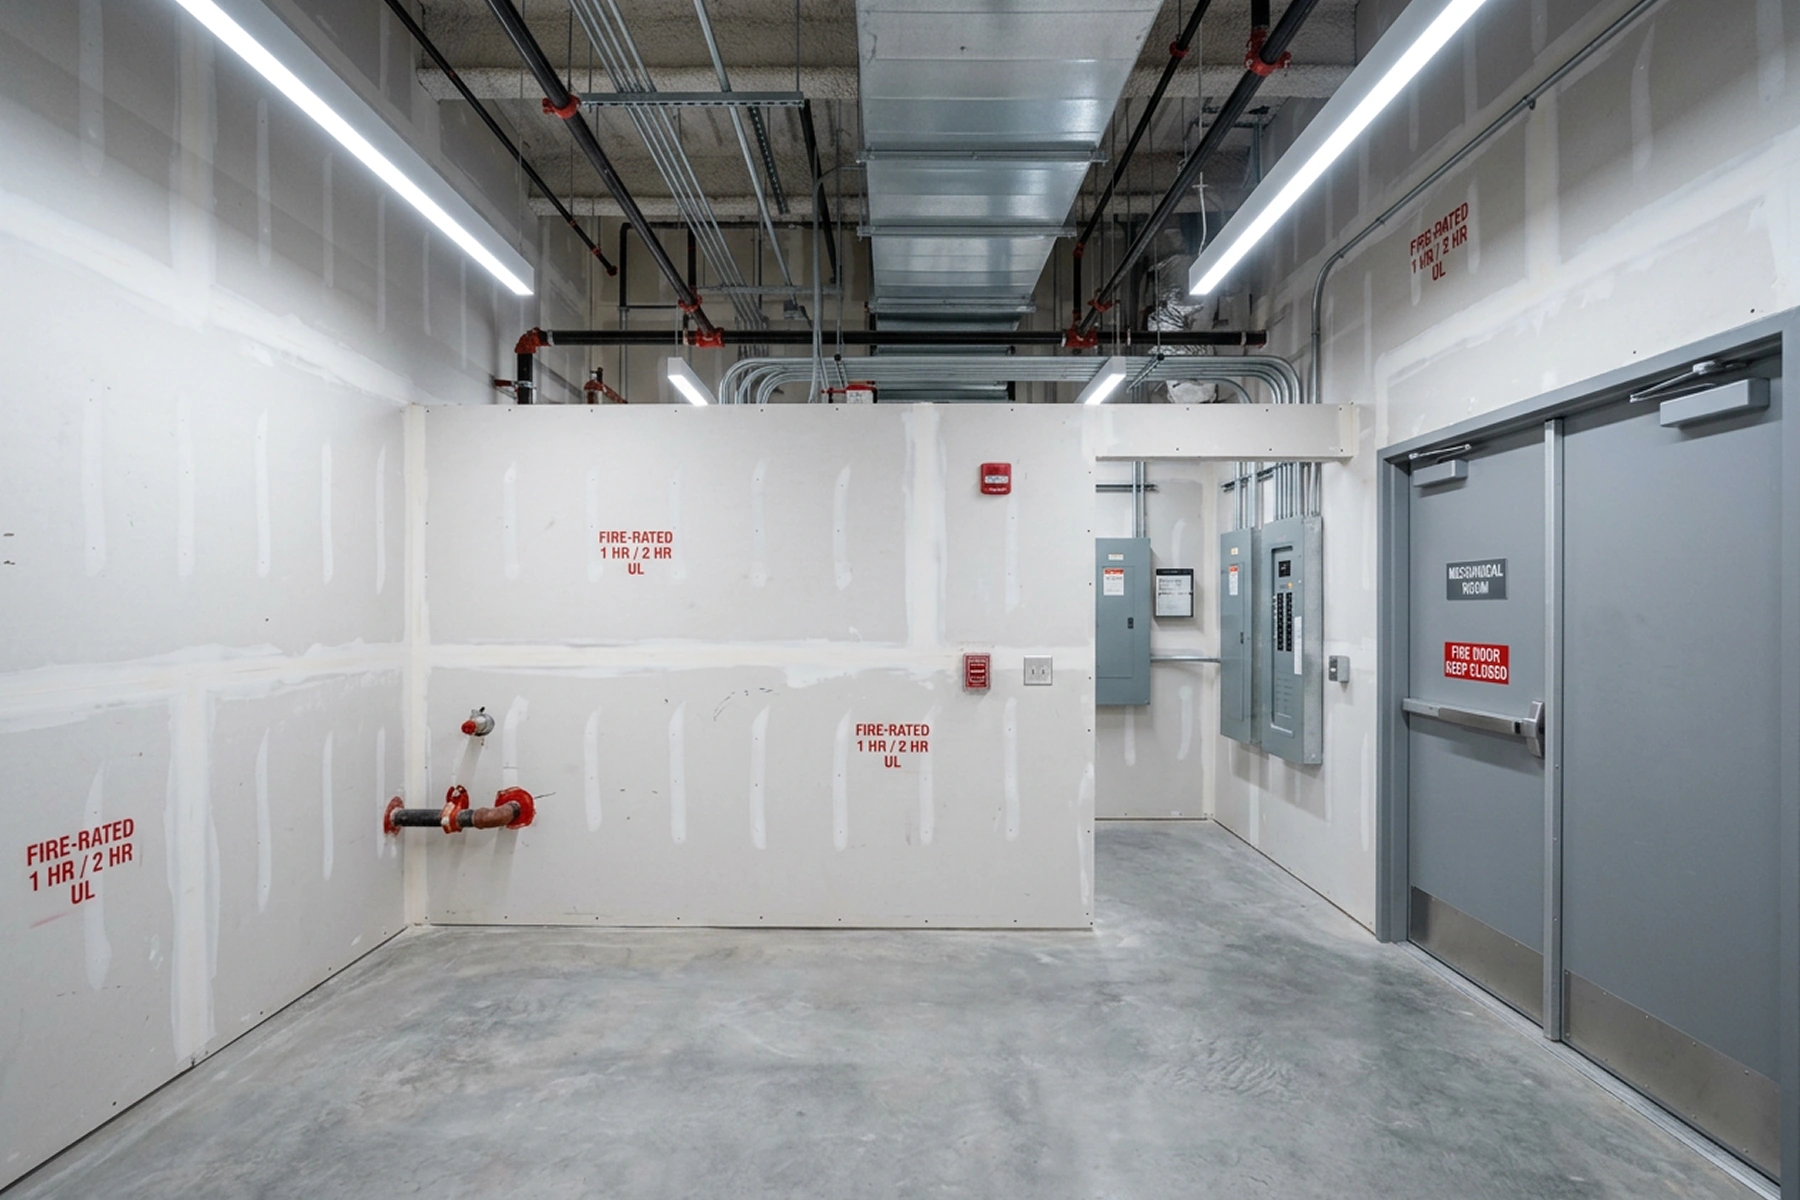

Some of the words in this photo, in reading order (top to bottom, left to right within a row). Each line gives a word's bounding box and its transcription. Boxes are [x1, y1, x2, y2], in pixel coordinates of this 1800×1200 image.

[1452, 224, 1468, 249] HR
[1432, 260, 1446, 281] UL
[599, 531, 673, 544] FIRE-RATED
[600, 547, 606, 559] 1
[612, 547, 630, 559] HR
[633, 547, 639, 560] /
[642, 547, 650, 559] 2
[654, 547, 672, 559] HR
[628, 562, 644, 575] UL
[856, 723, 930, 736] FIRE-RATED
[857, 740, 863, 752] 1
[868, 740, 886, 752] HR
[890, 740, 896, 753] /
[899, 740, 907, 752] 2
[911, 740, 929, 752] HR
[884, 755, 901, 768] UL
[26, 818, 134, 867] FIRE-RATED
[29, 870, 38, 891] 1
[48, 860, 75, 887] HR
[79, 854, 88, 879] /
[92, 851, 103, 872] 2
[109, 843, 133, 867] HR
[71, 880, 95, 904] UL
